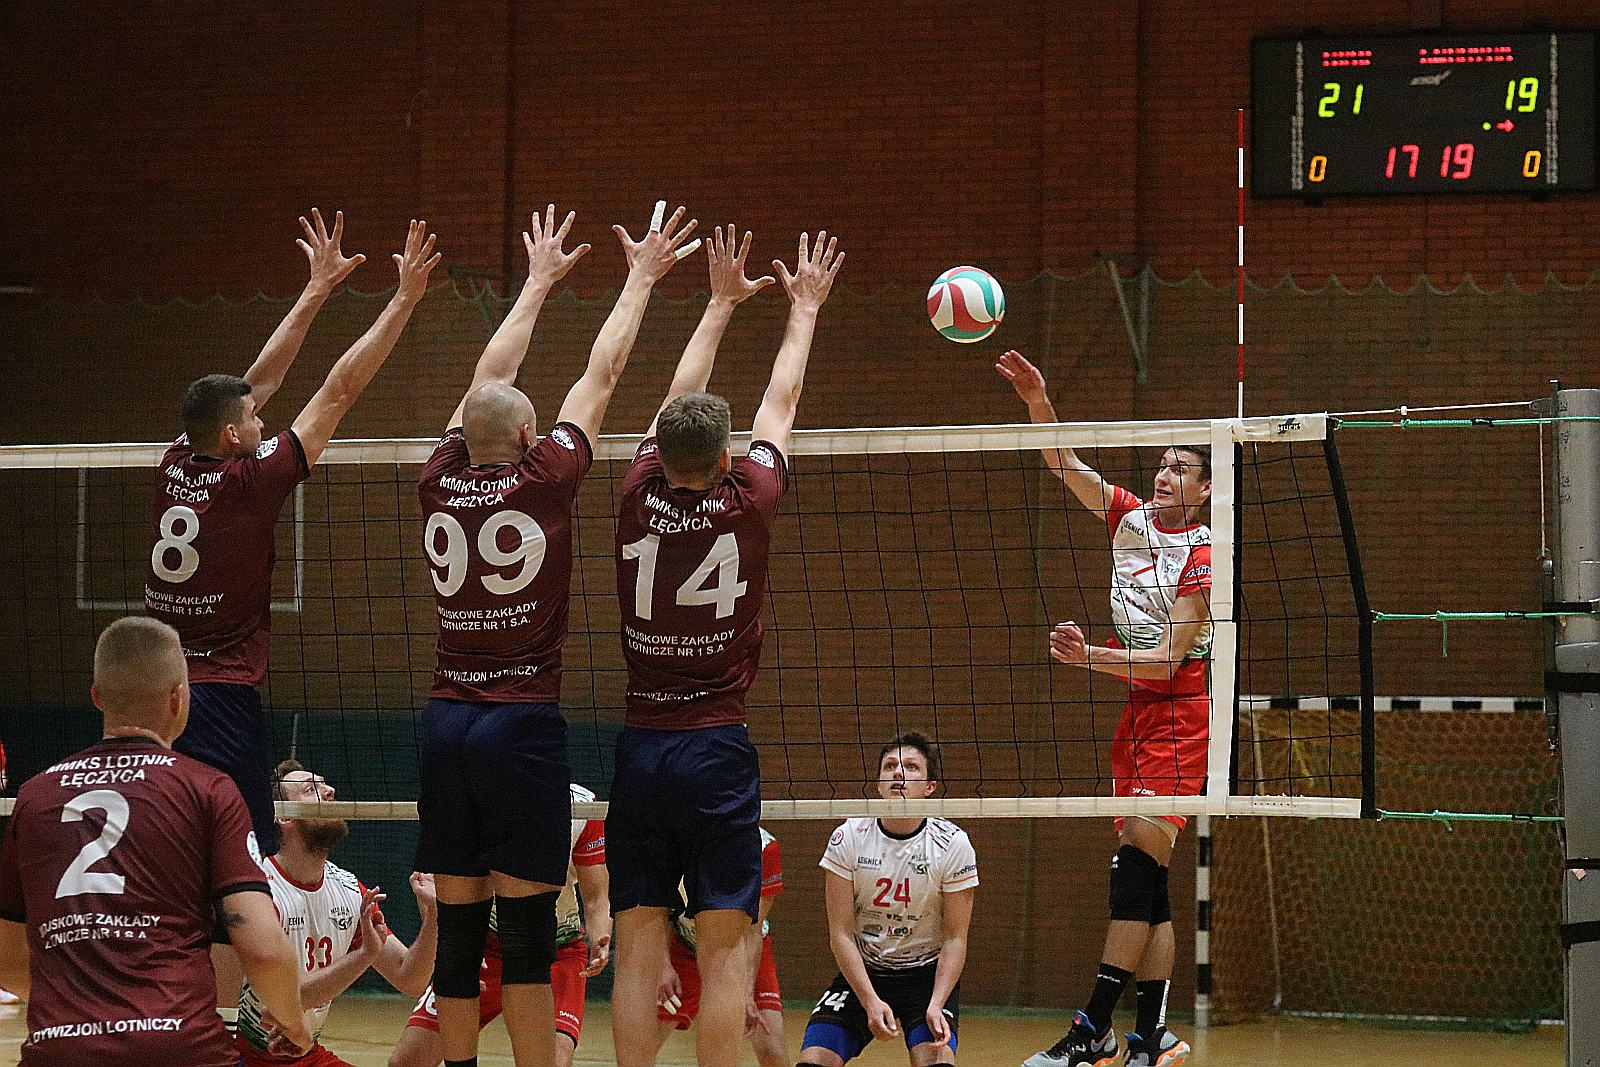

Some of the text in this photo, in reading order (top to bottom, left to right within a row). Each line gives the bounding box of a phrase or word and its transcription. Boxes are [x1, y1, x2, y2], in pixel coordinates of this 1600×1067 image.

[1318, 82, 1363, 117] 21
[1505, 77, 1538, 112] 19
[1309, 156, 1327, 182] 0
[1385, 144, 1420, 178] 17
[1440, 143, 1474, 179] 19
[1522, 150, 1541, 177] 0
[471, 473, 519, 493] LOTNIK
[446, 493, 504, 510] ŁĘCZYCA
[152, 505, 200, 583] 8
[425, 510, 547, 597] 99
[622, 532, 748, 620] 14
[1184, 565, 1211, 580] profit
[175, 593, 224, 605] ZAKŁADY
[485, 600, 538, 618] ZAKŁADY
[172, 606, 185, 615] NR
[187, 607, 192, 615] 1
[483, 621, 499, 630] NR
[501, 620, 506, 629] 1
[510, 615, 531, 627] S.A.
[628, 638, 675, 656] LOTNICZE
[677, 647, 694, 657] NR
[698, 648, 703, 657] 1
[681, 628, 735, 646] ZAKŁADY
[45, 754, 177, 774] MMKS LOTNIK
[60, 769, 145, 788] ŁĘCZYCA
[55, 789, 130, 899] 2
[872, 877, 911, 908] 24
[95, 914, 161, 927] ZAKŁADY
[92, 927, 110, 940] NR
[305, 936, 333, 973] 33
[33, 1021, 102, 1043] DYWIZJON
[106, 1018, 182, 1034] LOTNICZY
